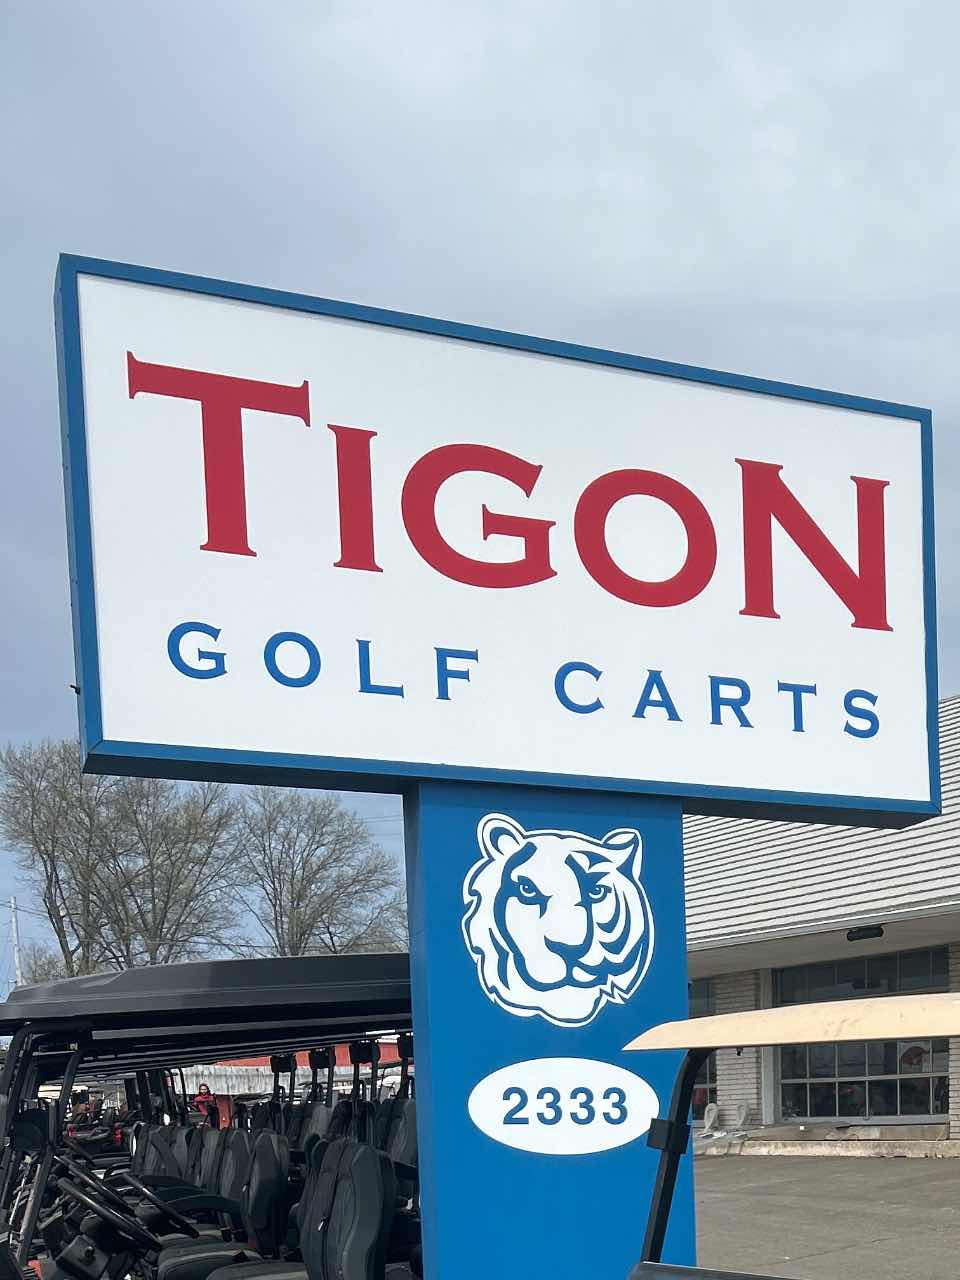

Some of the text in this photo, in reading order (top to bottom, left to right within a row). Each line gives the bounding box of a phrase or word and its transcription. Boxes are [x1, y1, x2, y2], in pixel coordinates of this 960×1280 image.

[127, 350, 894, 633] TIGON
[166, 621, 881, 740] GOLF CARTS
[502, 1086, 628, 1126] 2333
